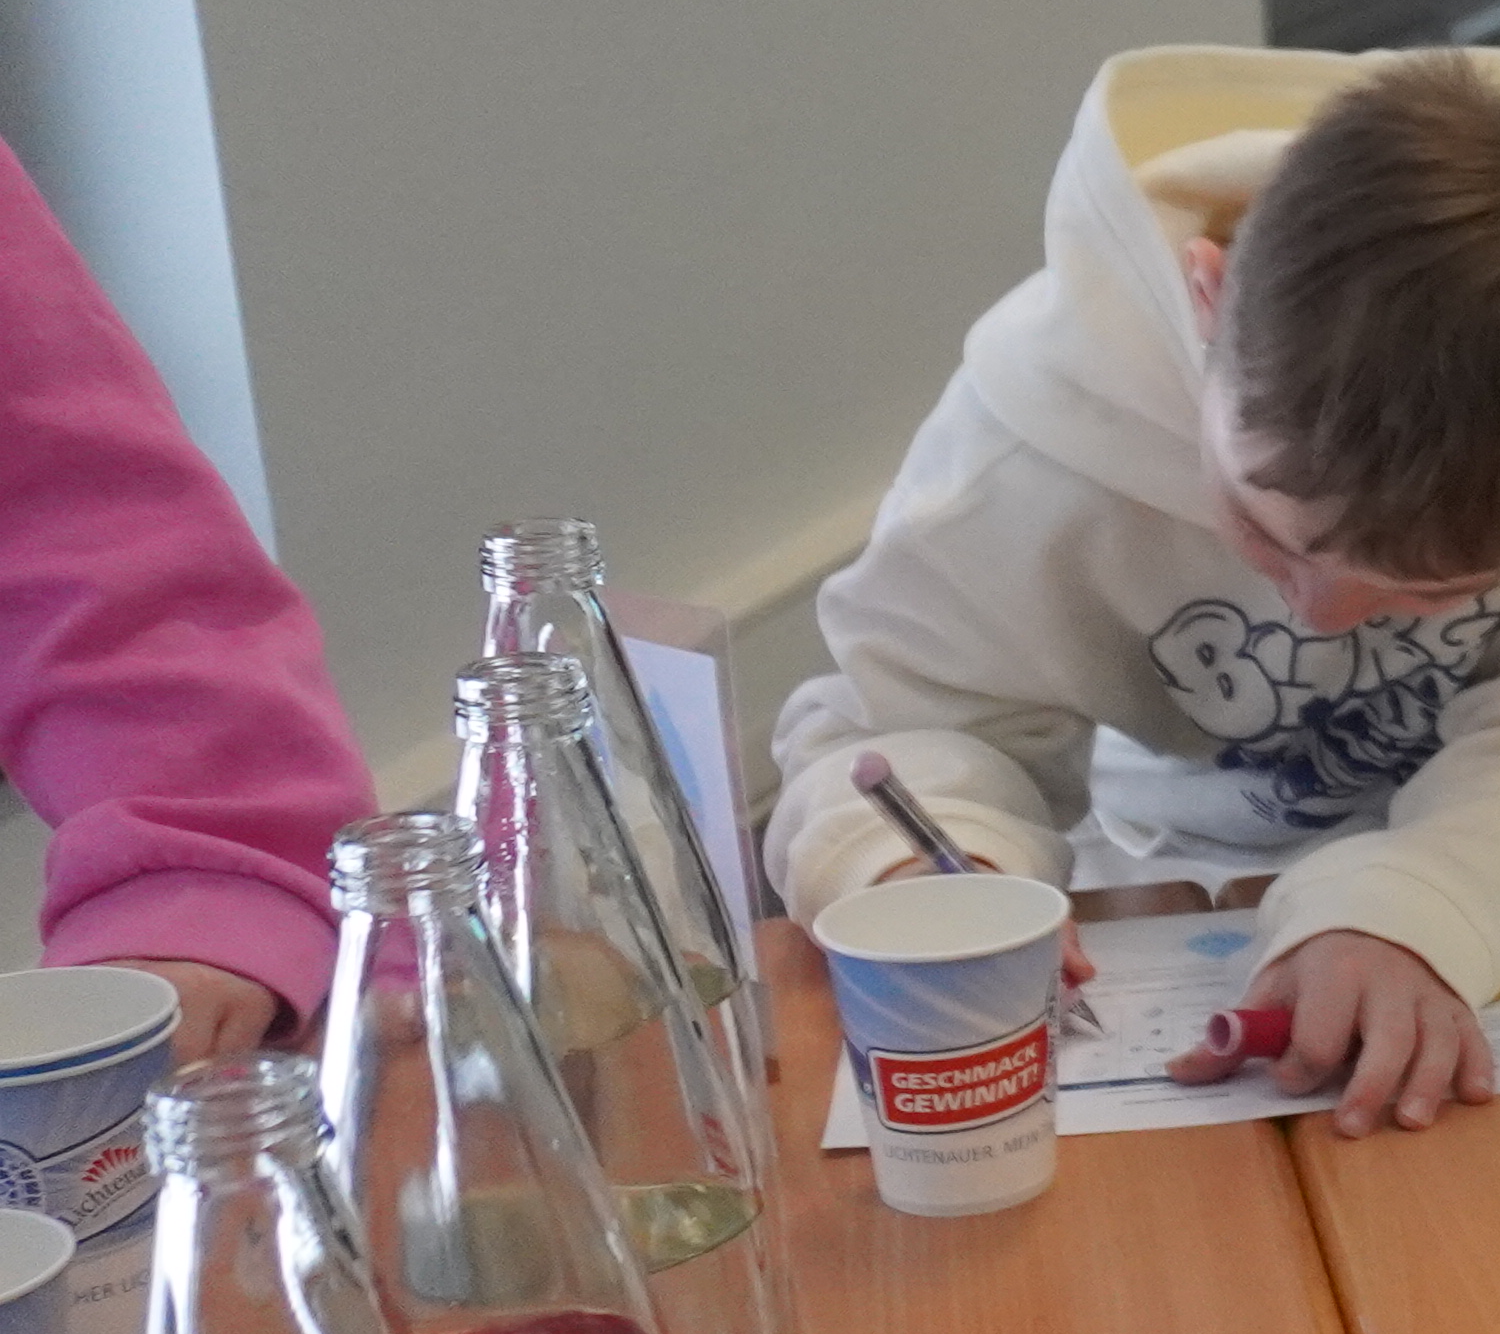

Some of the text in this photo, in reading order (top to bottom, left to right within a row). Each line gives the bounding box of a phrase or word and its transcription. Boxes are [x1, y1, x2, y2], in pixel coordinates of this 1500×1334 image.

[892, 1042, 1038, 1089] GESCHMACK
[895, 1065, 1040, 1113] GEWINNT!
[60, 1163, 147, 1227] Lichtena
